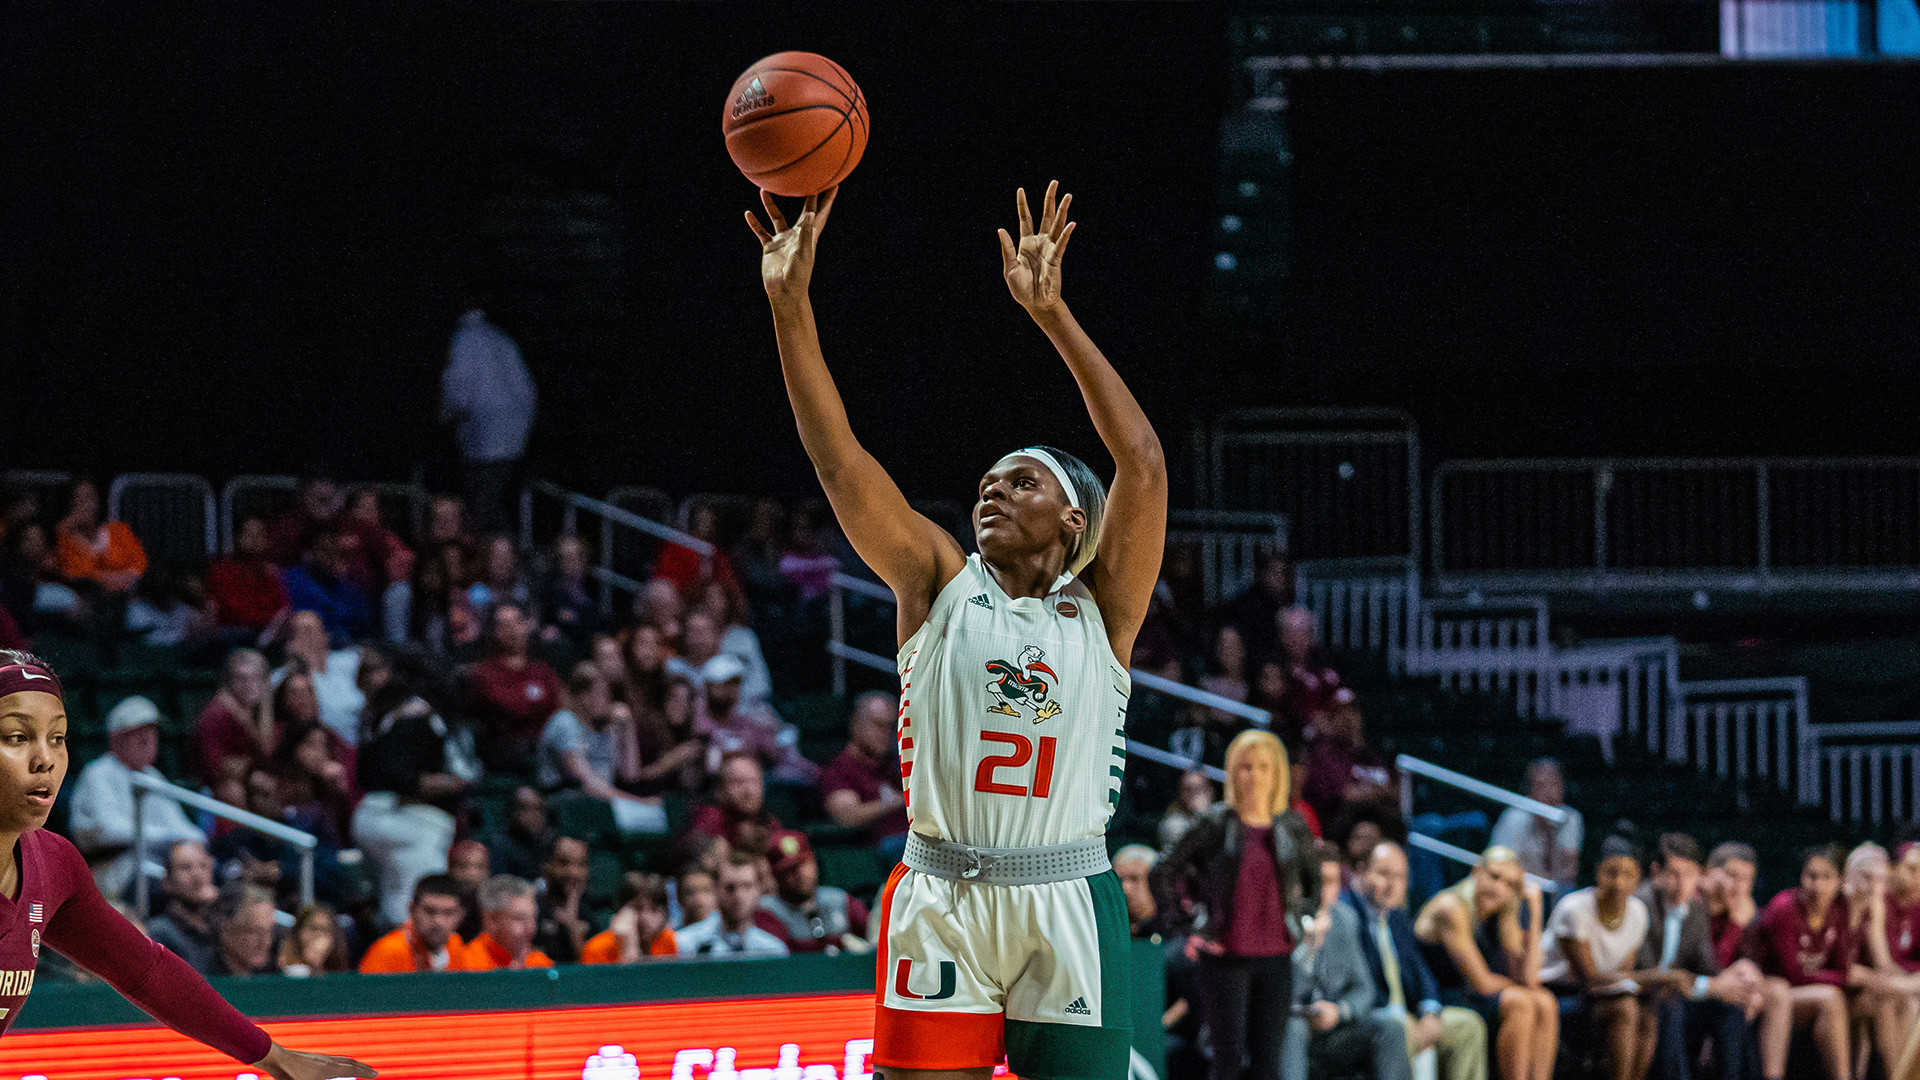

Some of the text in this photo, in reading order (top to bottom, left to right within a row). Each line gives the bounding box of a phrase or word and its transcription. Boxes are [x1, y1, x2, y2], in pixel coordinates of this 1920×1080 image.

[974, 730, 1057, 798] 21
[894, 957, 957, 1000] U
[1064, 1006, 1092, 1016] adidas
